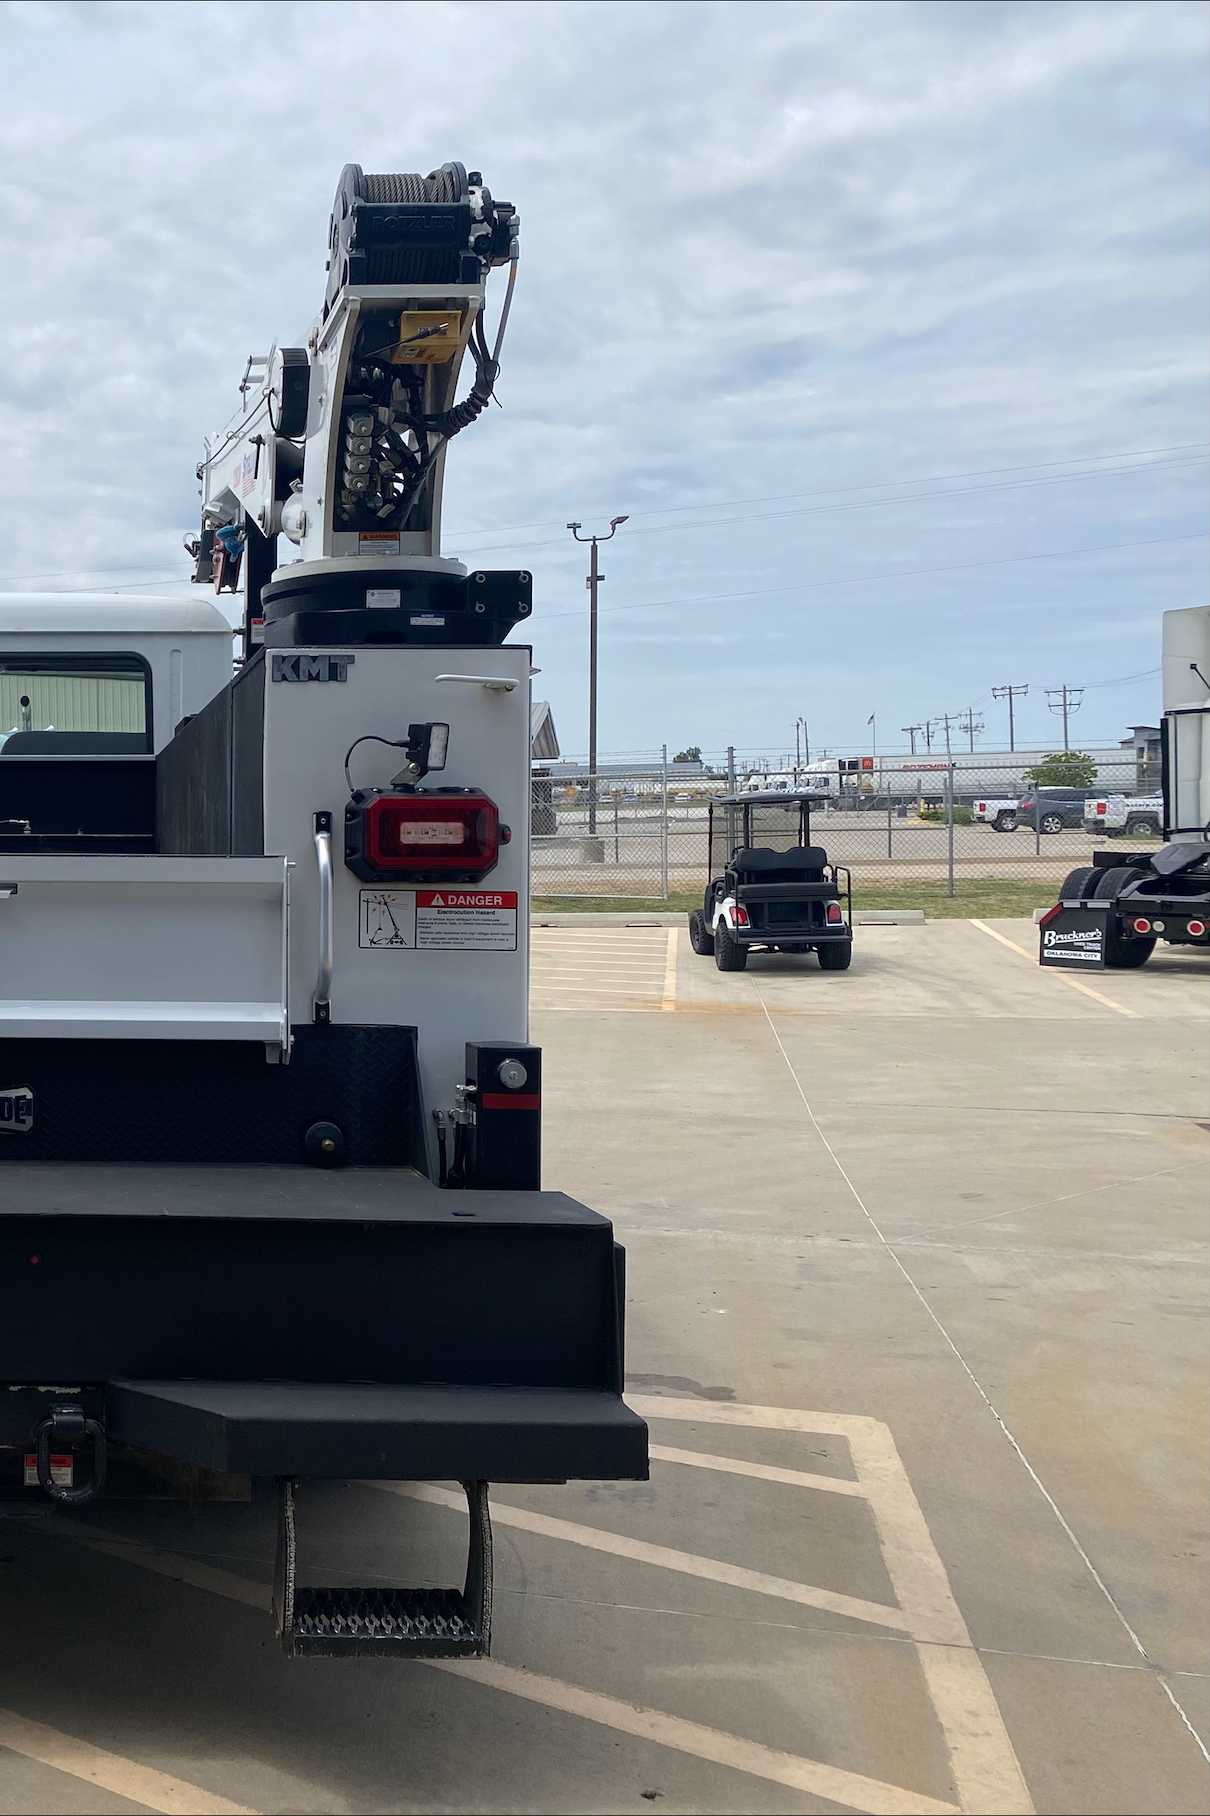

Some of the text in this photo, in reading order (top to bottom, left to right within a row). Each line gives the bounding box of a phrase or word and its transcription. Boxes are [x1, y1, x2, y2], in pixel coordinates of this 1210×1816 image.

[271, 654, 355, 682] KMT
[447, 895, 503, 906] DANGER
[1044, 928, 1102, 946] Bruckner's
